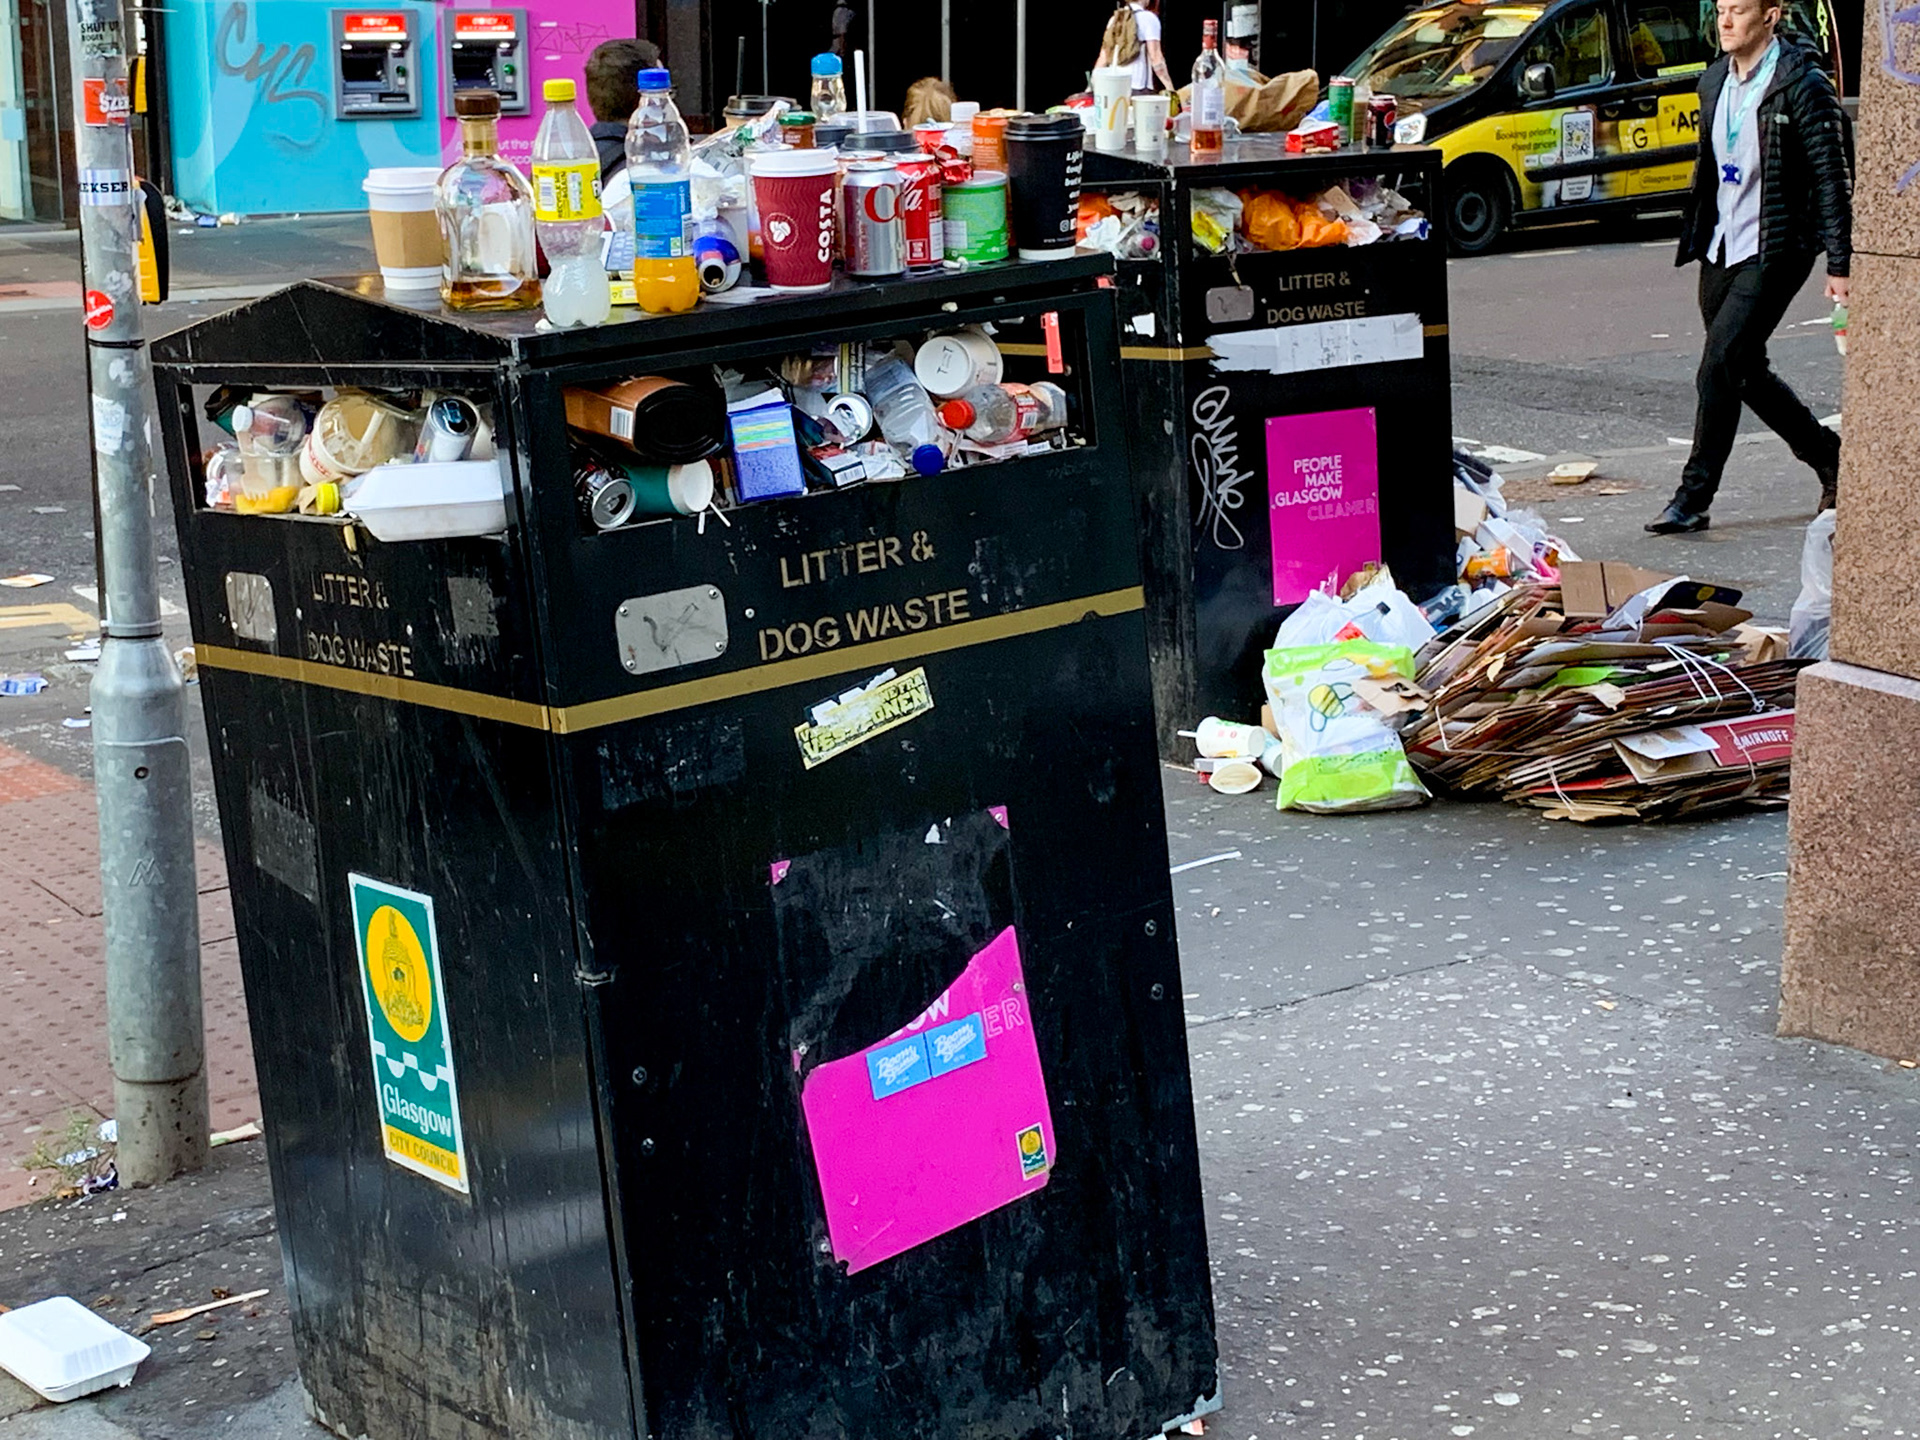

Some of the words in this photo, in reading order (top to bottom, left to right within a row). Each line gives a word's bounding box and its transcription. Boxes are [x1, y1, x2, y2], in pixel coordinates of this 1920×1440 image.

[80, 21, 106, 33] SHUT
[817, 188, 832, 263] COSTA
[1279, 272, 1335, 291] LITTER
[1339, 271, 1351, 286] &
[1267, 306, 1305, 325] DOG
[1307, 301, 1366, 320] WASTE
[1294, 454, 1342, 474] PEOPLE
[1305, 470, 1342, 488] MAKE
[1275, 486, 1343, 507] GLASGOW
[780, 536, 905, 589] LITTER
[911, 530, 936, 562] &
[311, 571, 373, 609] LITTER
[758, 616, 841, 661] DOG
[845, 588, 971, 641] WASTE
[307, 631, 346, 665] DOG
[347, 636, 414, 677] WASTE
[802, 681, 929, 761] VESONEN
[1733, 729, 1789, 751] SMIRNOFF
[383, 1083, 452, 1138] Glasgow
[389, 1132, 409, 1153] CITY
[413, 1142, 457, 1174] COUNCIL
